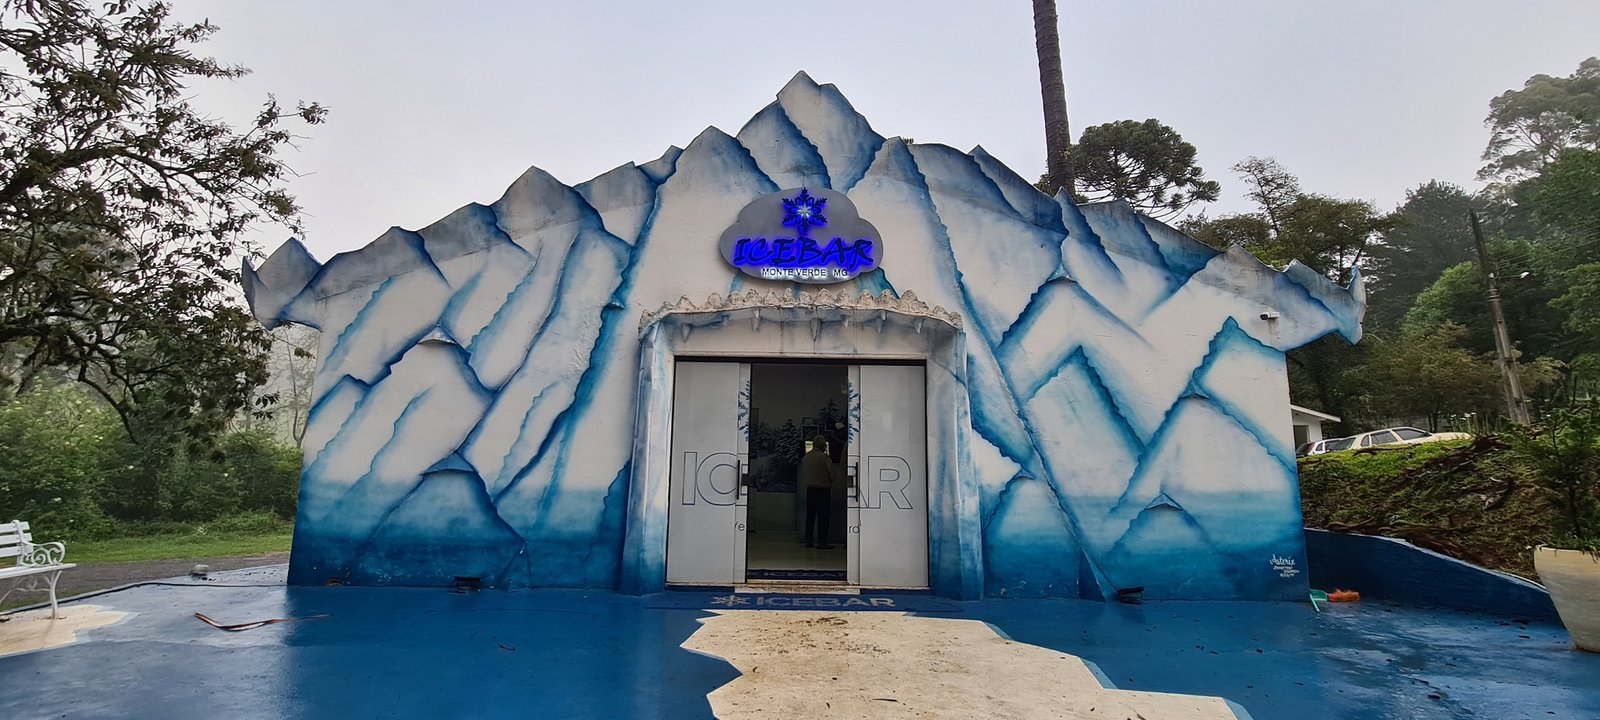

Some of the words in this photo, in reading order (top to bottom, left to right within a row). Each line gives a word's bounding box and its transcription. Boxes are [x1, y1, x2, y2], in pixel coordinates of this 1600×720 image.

[733, 236, 874, 270] ICEBAR
[762, 268, 794, 276] MONTE
[795, 268, 826, 277] VERDE
[833, 269, 848, 277] MG
[756, 597, 896, 607] ICEBAR
